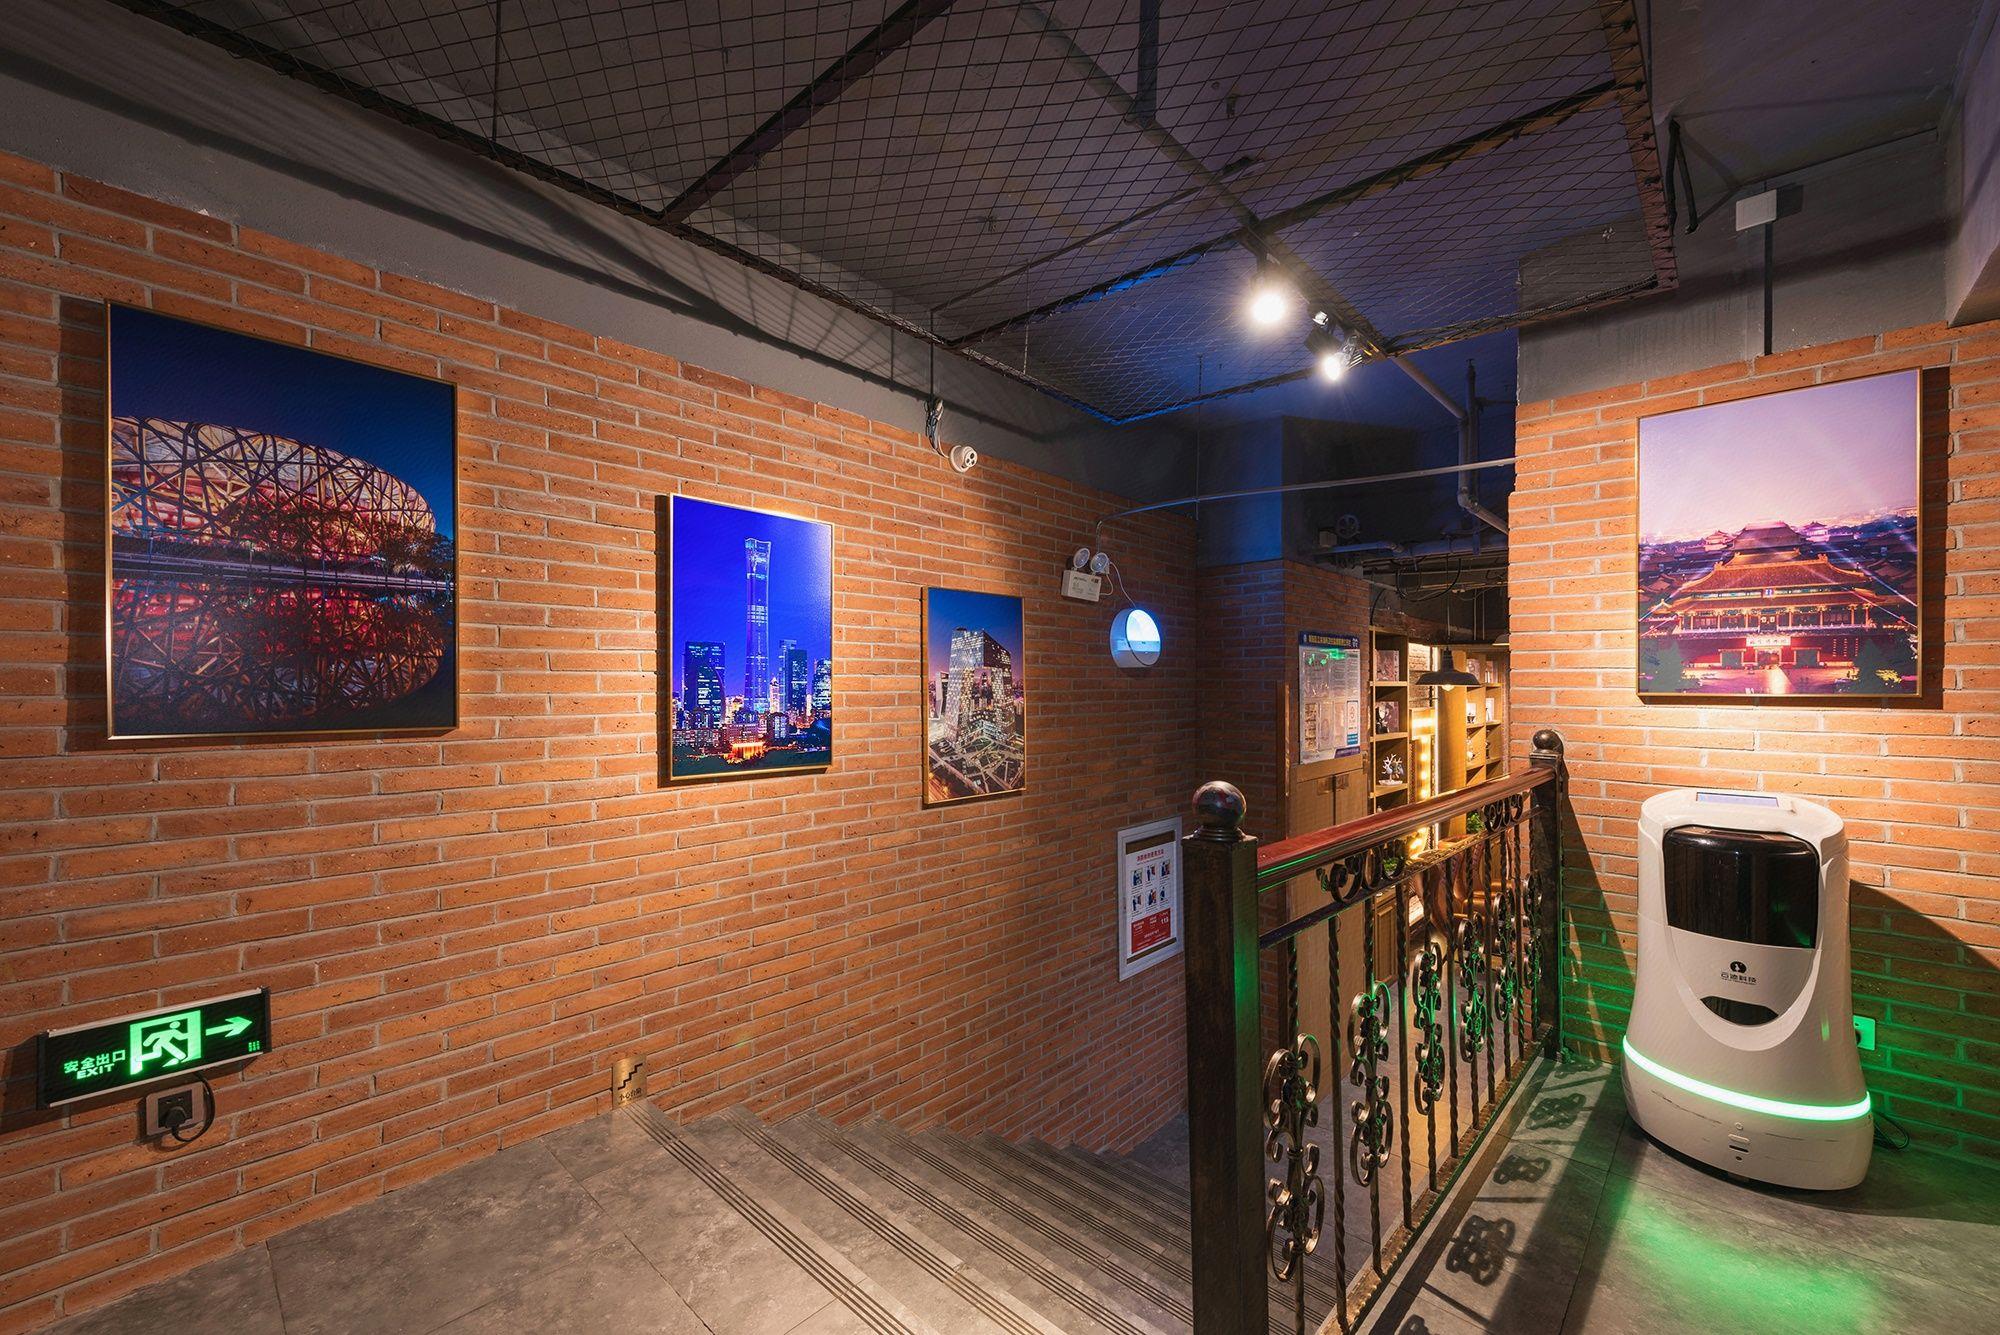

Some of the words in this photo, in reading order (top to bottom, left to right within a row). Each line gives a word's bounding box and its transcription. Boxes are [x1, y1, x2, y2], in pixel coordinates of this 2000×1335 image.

[64, 1049, 126, 1074] 安全出口
[76, 1063, 115, 1080] EXIT
